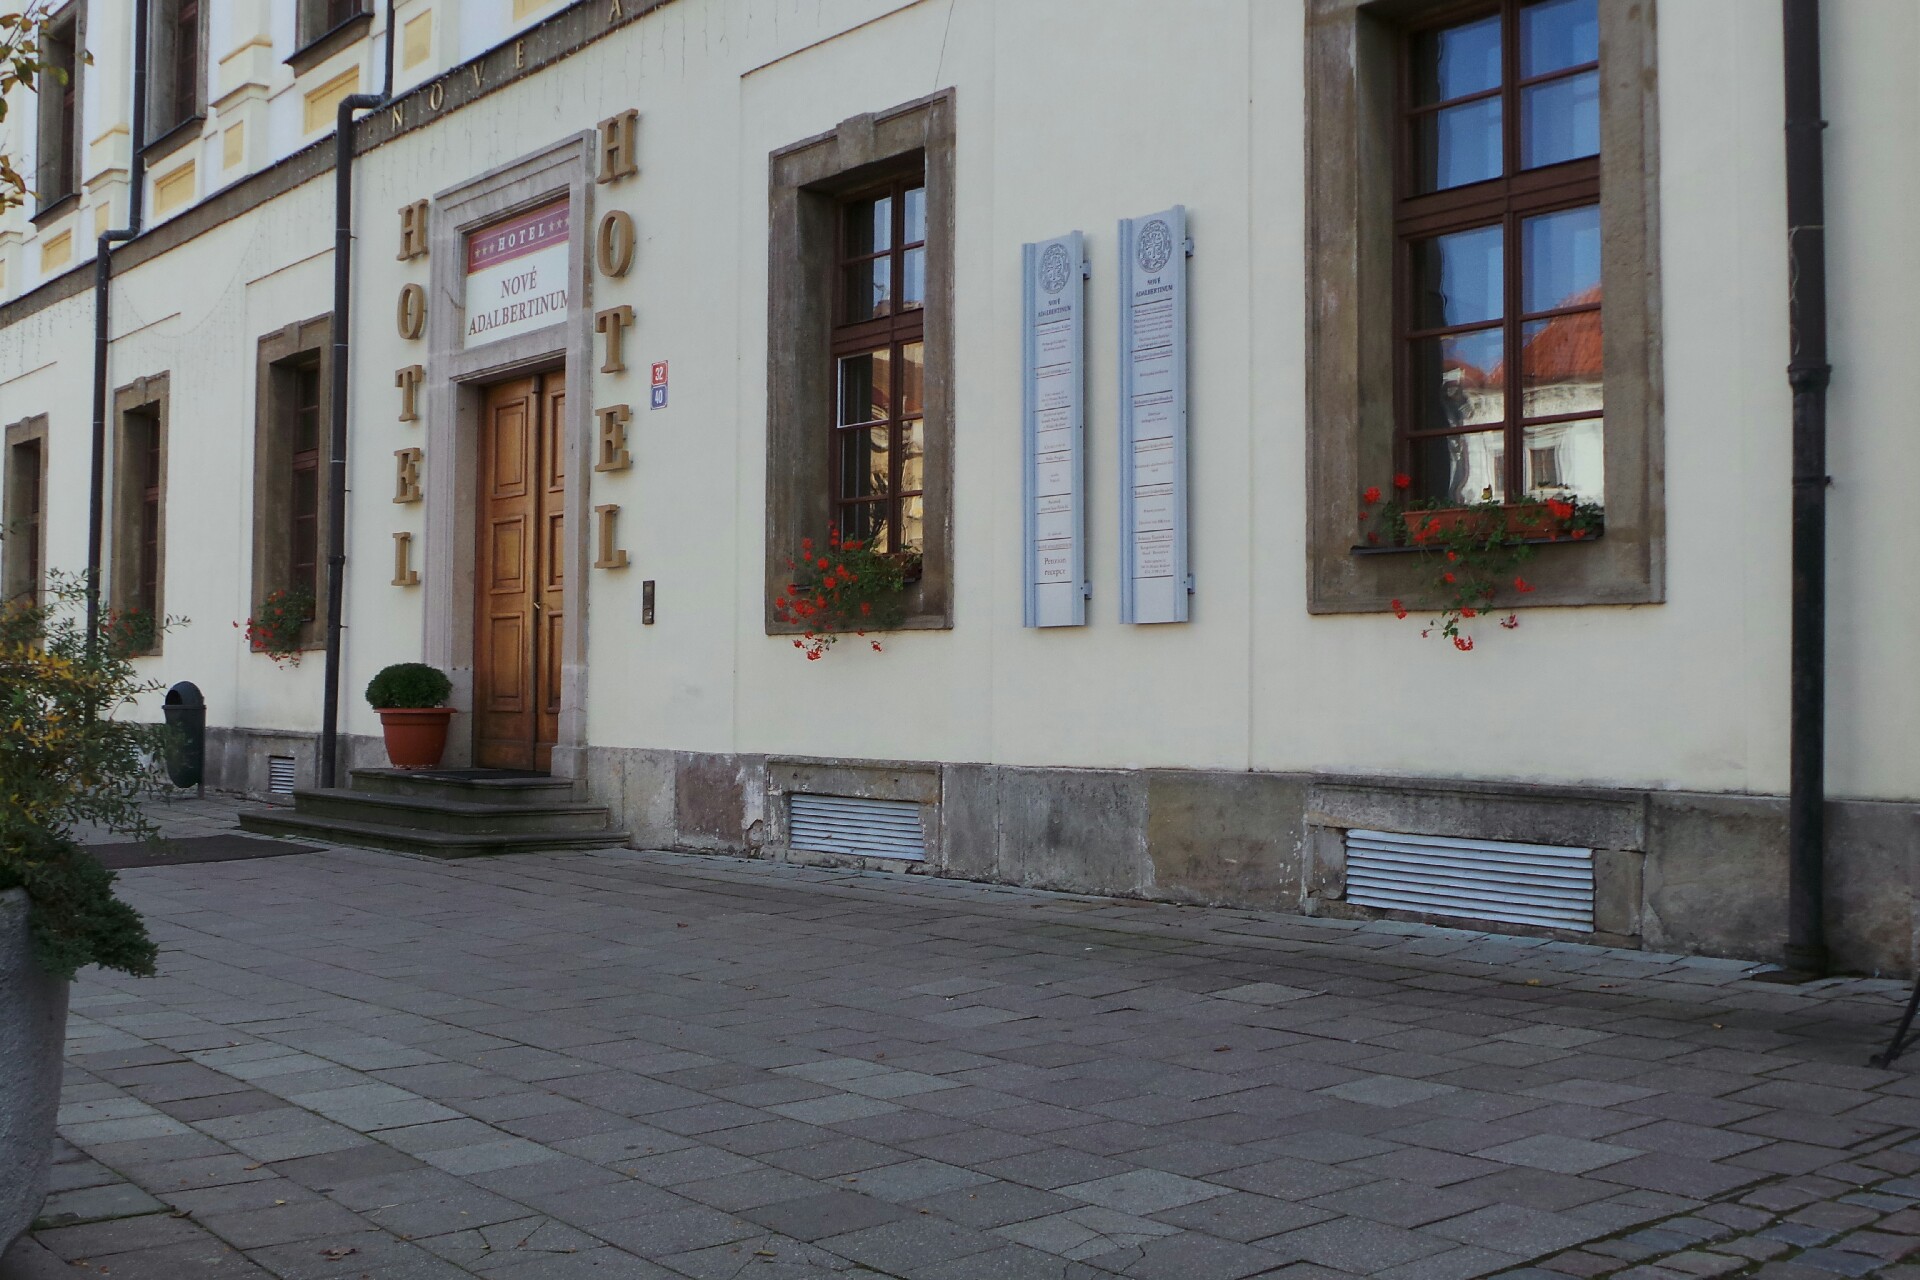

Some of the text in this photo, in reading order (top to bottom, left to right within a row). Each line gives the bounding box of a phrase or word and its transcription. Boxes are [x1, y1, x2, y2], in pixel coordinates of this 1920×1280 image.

[498, 223, 545, 252] HOTEL
[500, 265, 537, 299] NOVÉ
[594, 107, 639, 570] HOTEL
[655, 366, 664, 381] 32
[391, 198, 429, 587] HOTEL
[655, 389, 663, 404] 40
